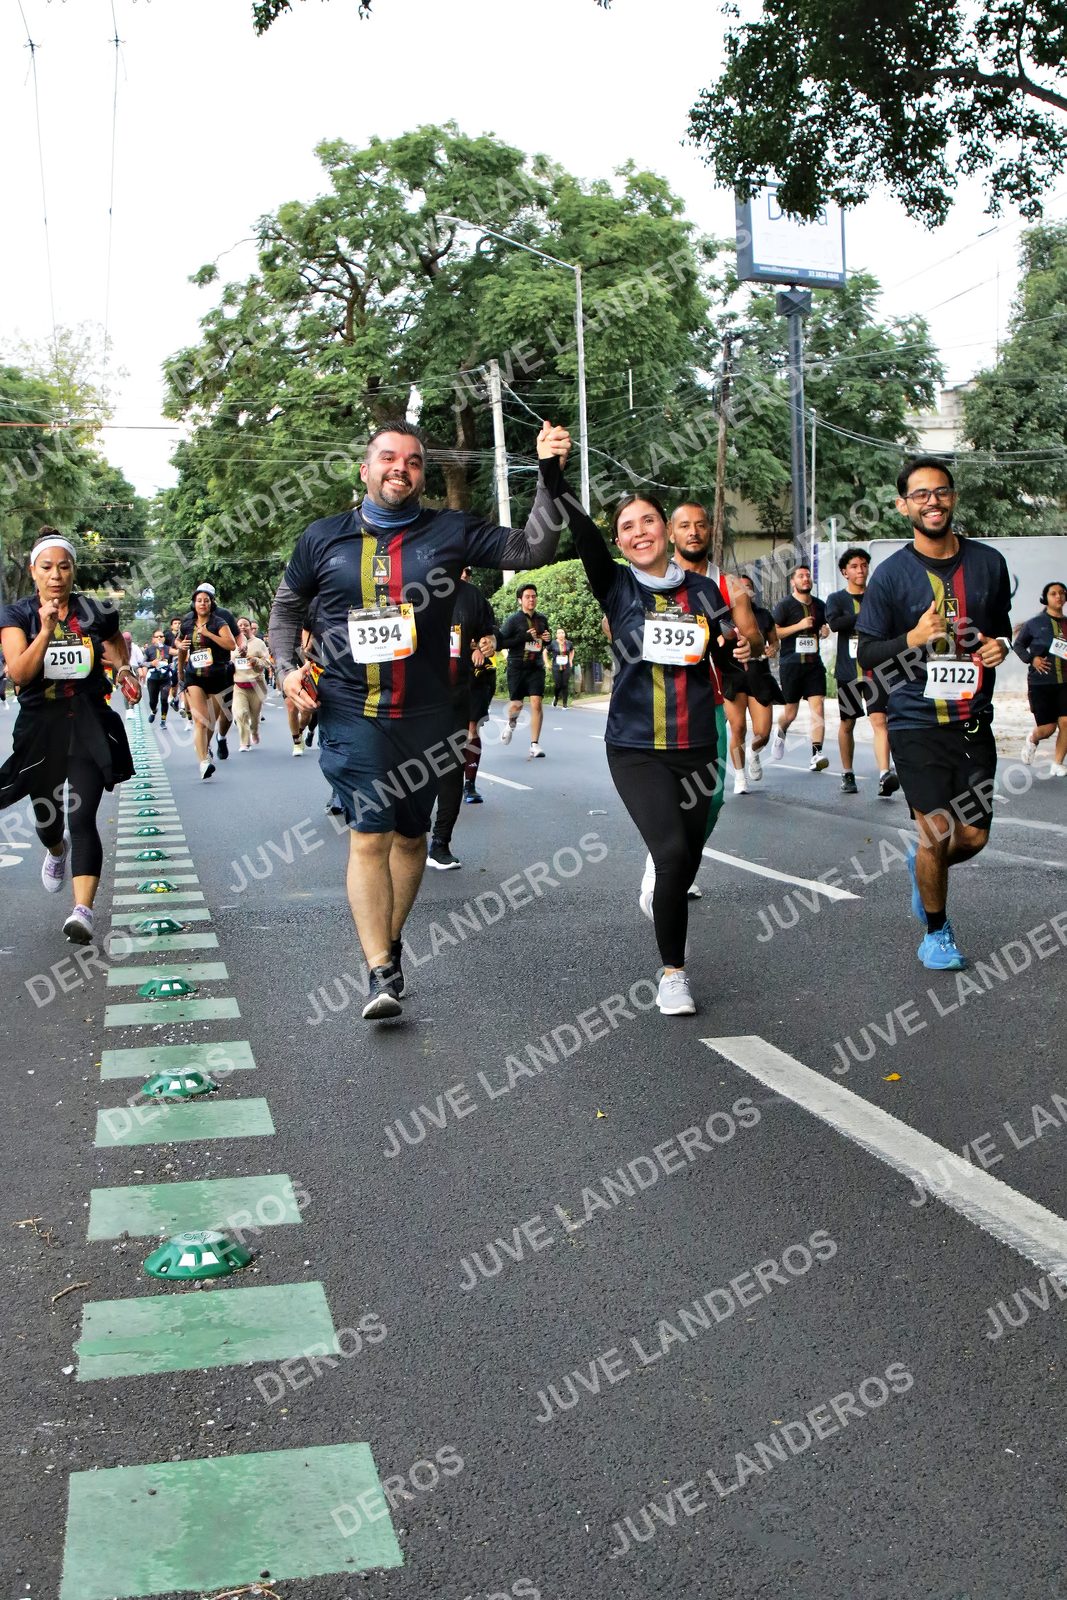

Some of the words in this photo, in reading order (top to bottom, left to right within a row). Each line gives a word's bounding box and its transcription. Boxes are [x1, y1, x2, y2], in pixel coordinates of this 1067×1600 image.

[357, 624, 402, 645] 3394
[652, 627, 695, 647] 3395
[50, 650, 83, 666] 2501
[931, 667, 975, 684] 12122
